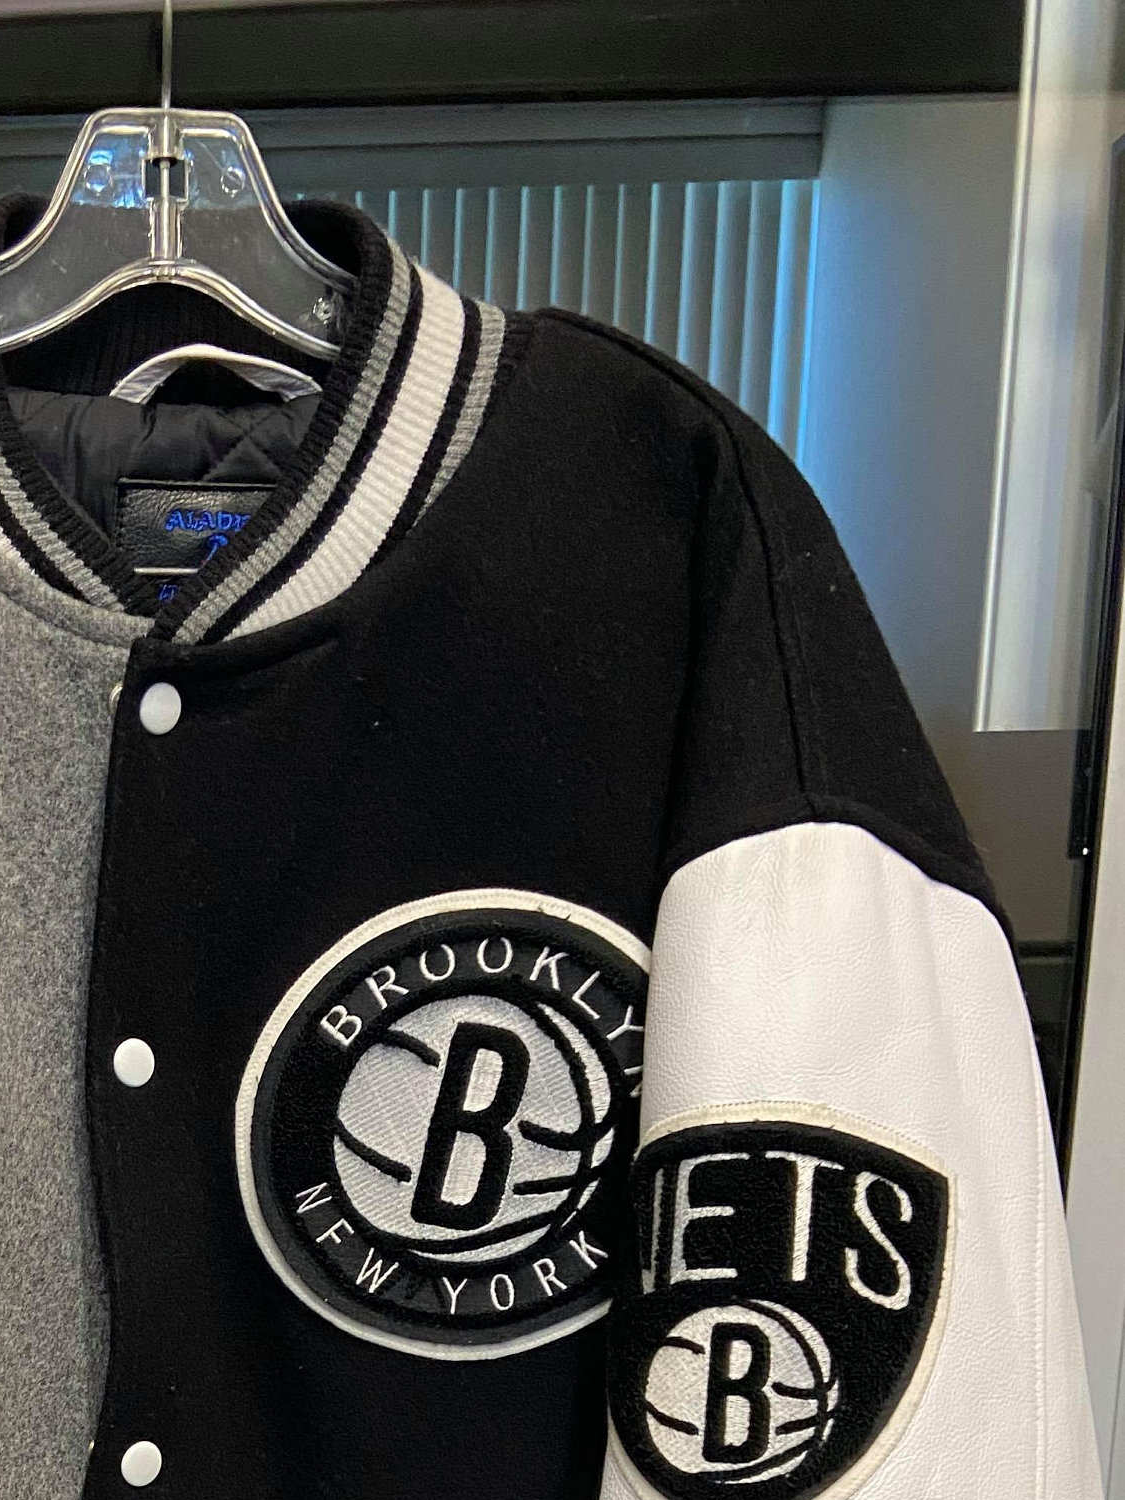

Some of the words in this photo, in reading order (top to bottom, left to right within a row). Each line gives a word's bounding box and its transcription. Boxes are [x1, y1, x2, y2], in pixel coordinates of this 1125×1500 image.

[319, 936, 645, 1098] BROOKLY
[409, 1020, 531, 1232] B
[441, 1230, 609, 1315] YORK
[701, 1321, 772, 1464] B
